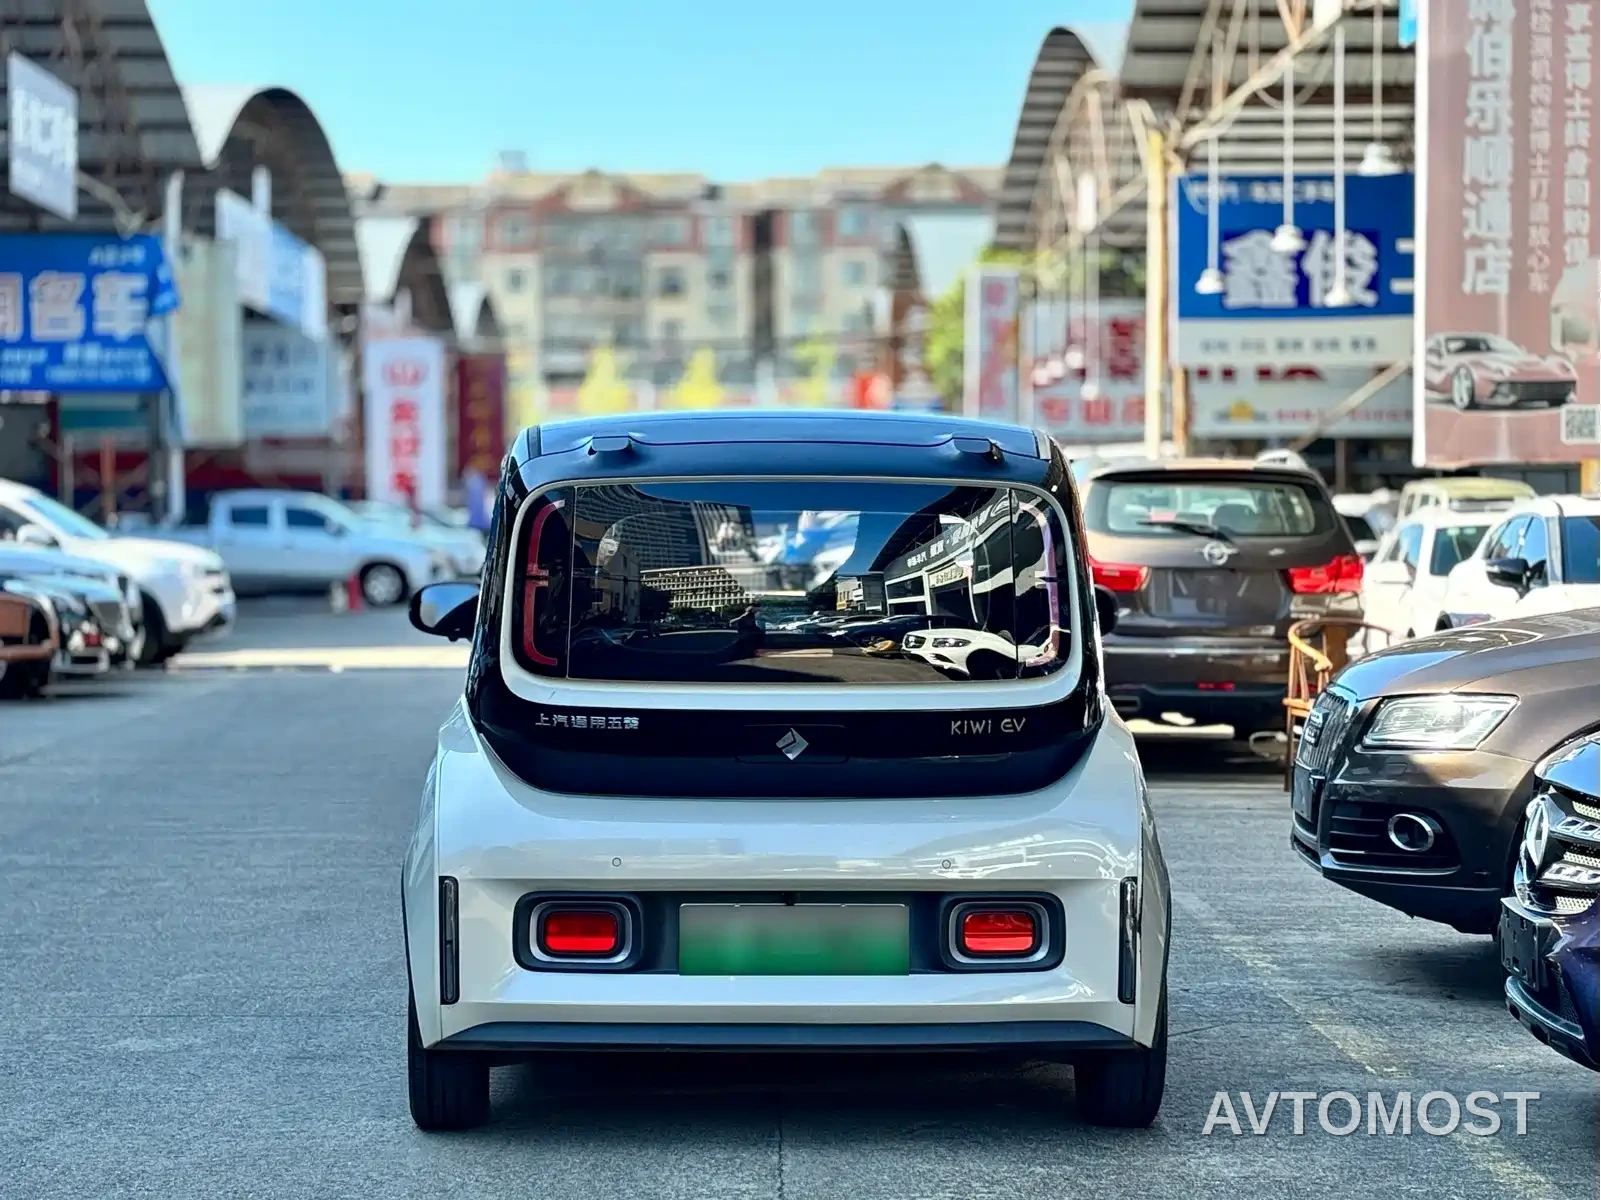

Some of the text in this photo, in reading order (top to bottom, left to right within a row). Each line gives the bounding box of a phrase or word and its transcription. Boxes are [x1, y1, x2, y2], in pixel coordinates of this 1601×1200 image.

[535, 712, 640, 730] 上汽通用五菱
[1000, 716, 1027, 733] EV
